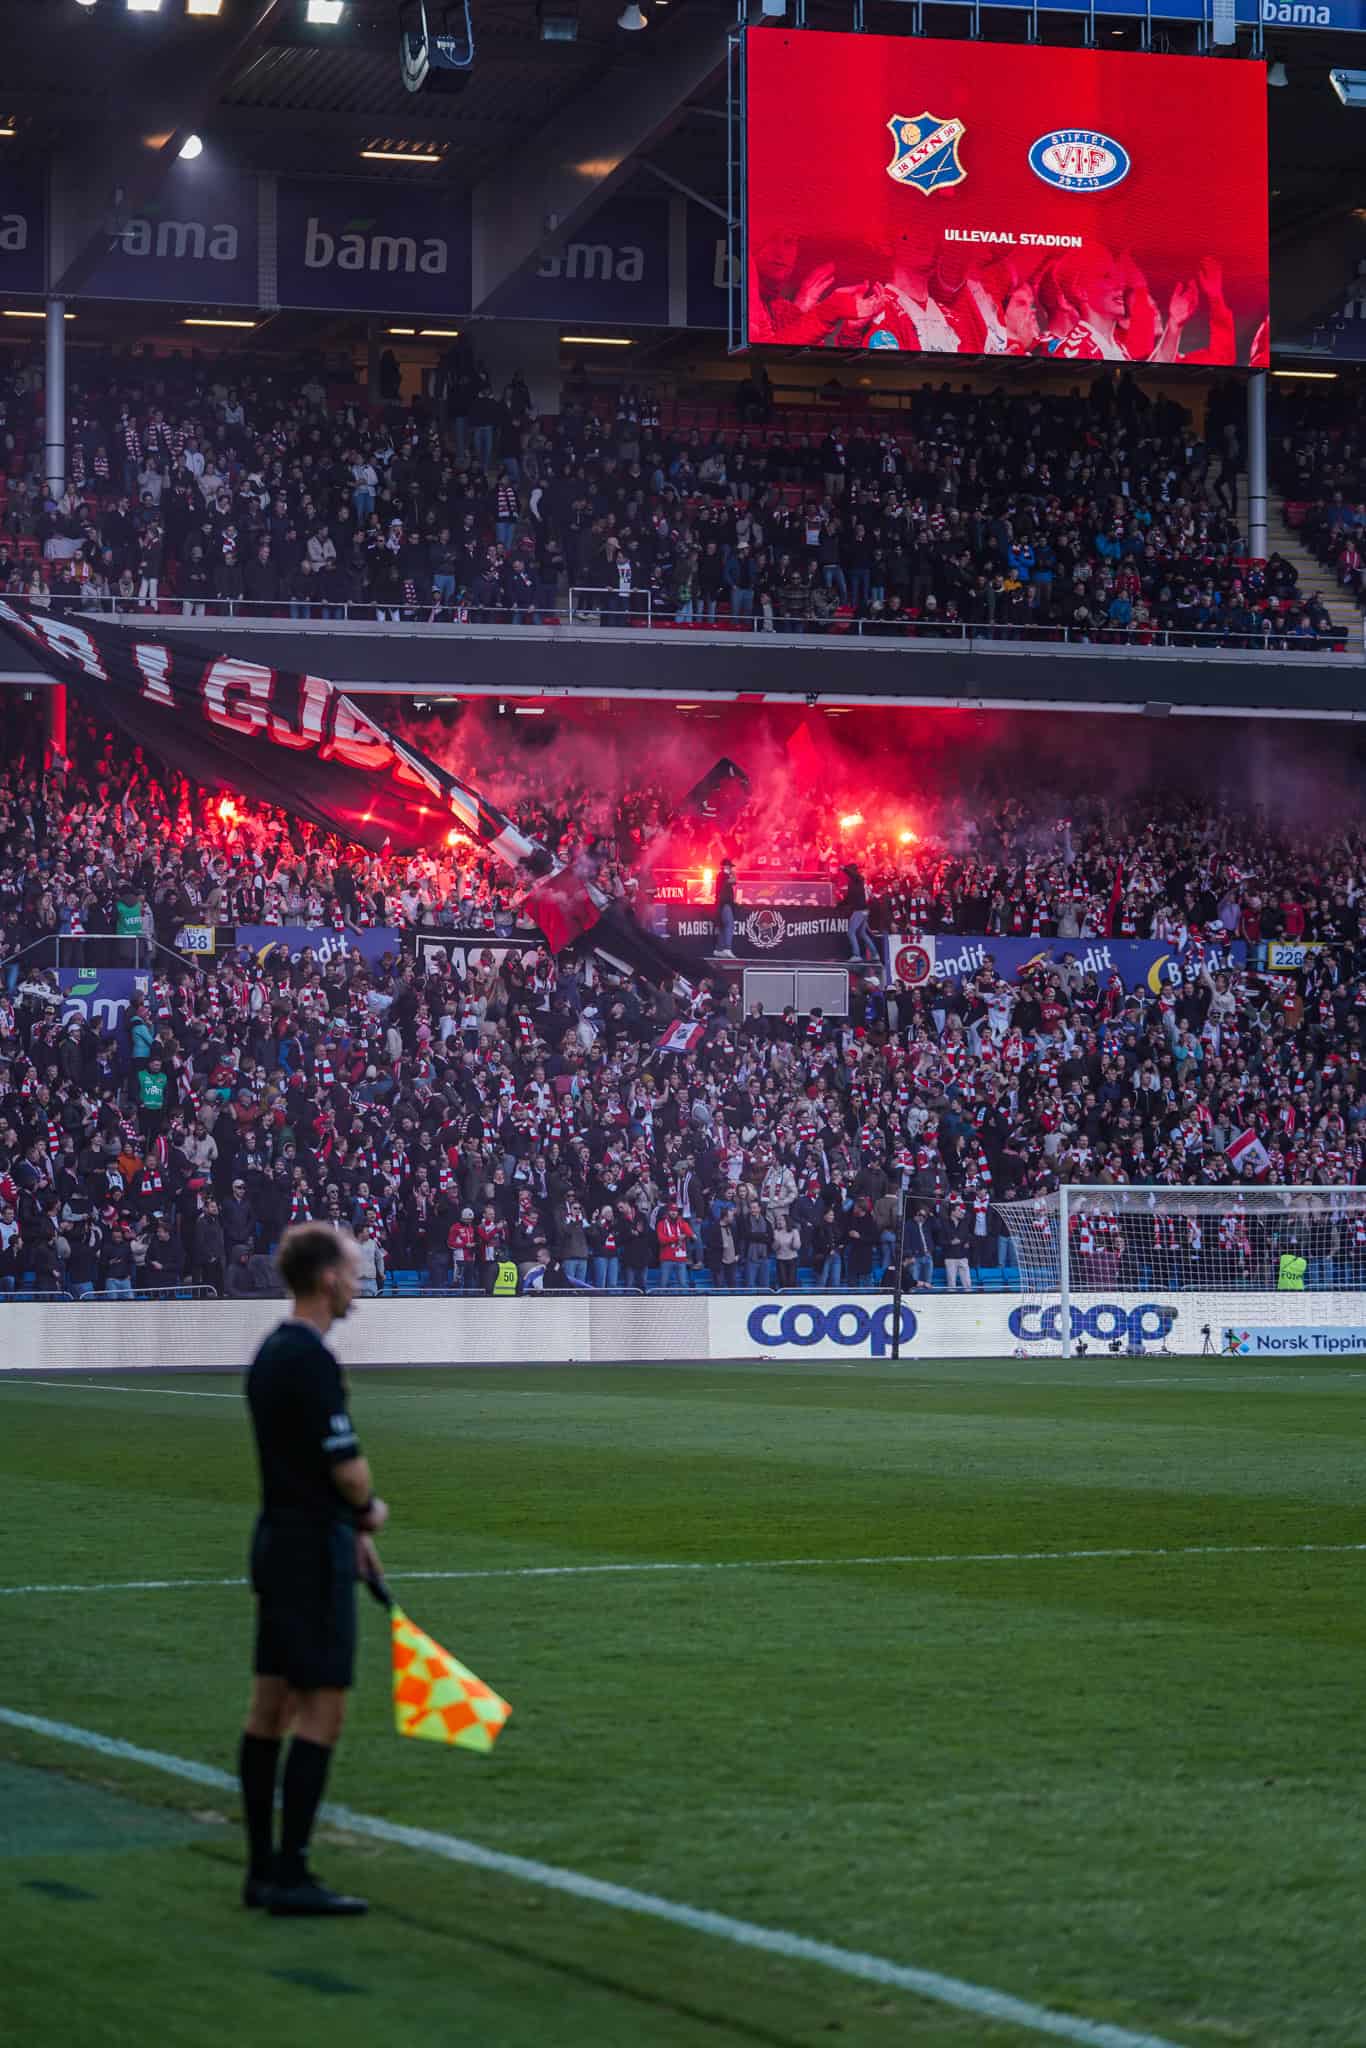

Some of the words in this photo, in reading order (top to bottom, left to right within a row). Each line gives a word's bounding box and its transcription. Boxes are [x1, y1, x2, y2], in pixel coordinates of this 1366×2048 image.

[1262, 0, 1330, 24] bama
[910, 135, 943, 164] LYN
[119, 214, 239, 260] ama
[304, 217, 448, 275] bama
[945, 229, 1016, 244] ULLEVAAL
[1020, 233, 1082, 247] STADION
[787, 918, 849, 937] CHRISTIANI
[933, 943, 986, 978] endit
[1275, 951, 1303, 965] 228
[503, 1271, 514, 1282] 50
[747, 1304, 917, 1356] coop
[1009, 1304, 1174, 1348] coop
[1256, 1335, 1309, 1350] Norsk
[1311, 1334, 1366, 1352] Tippin
